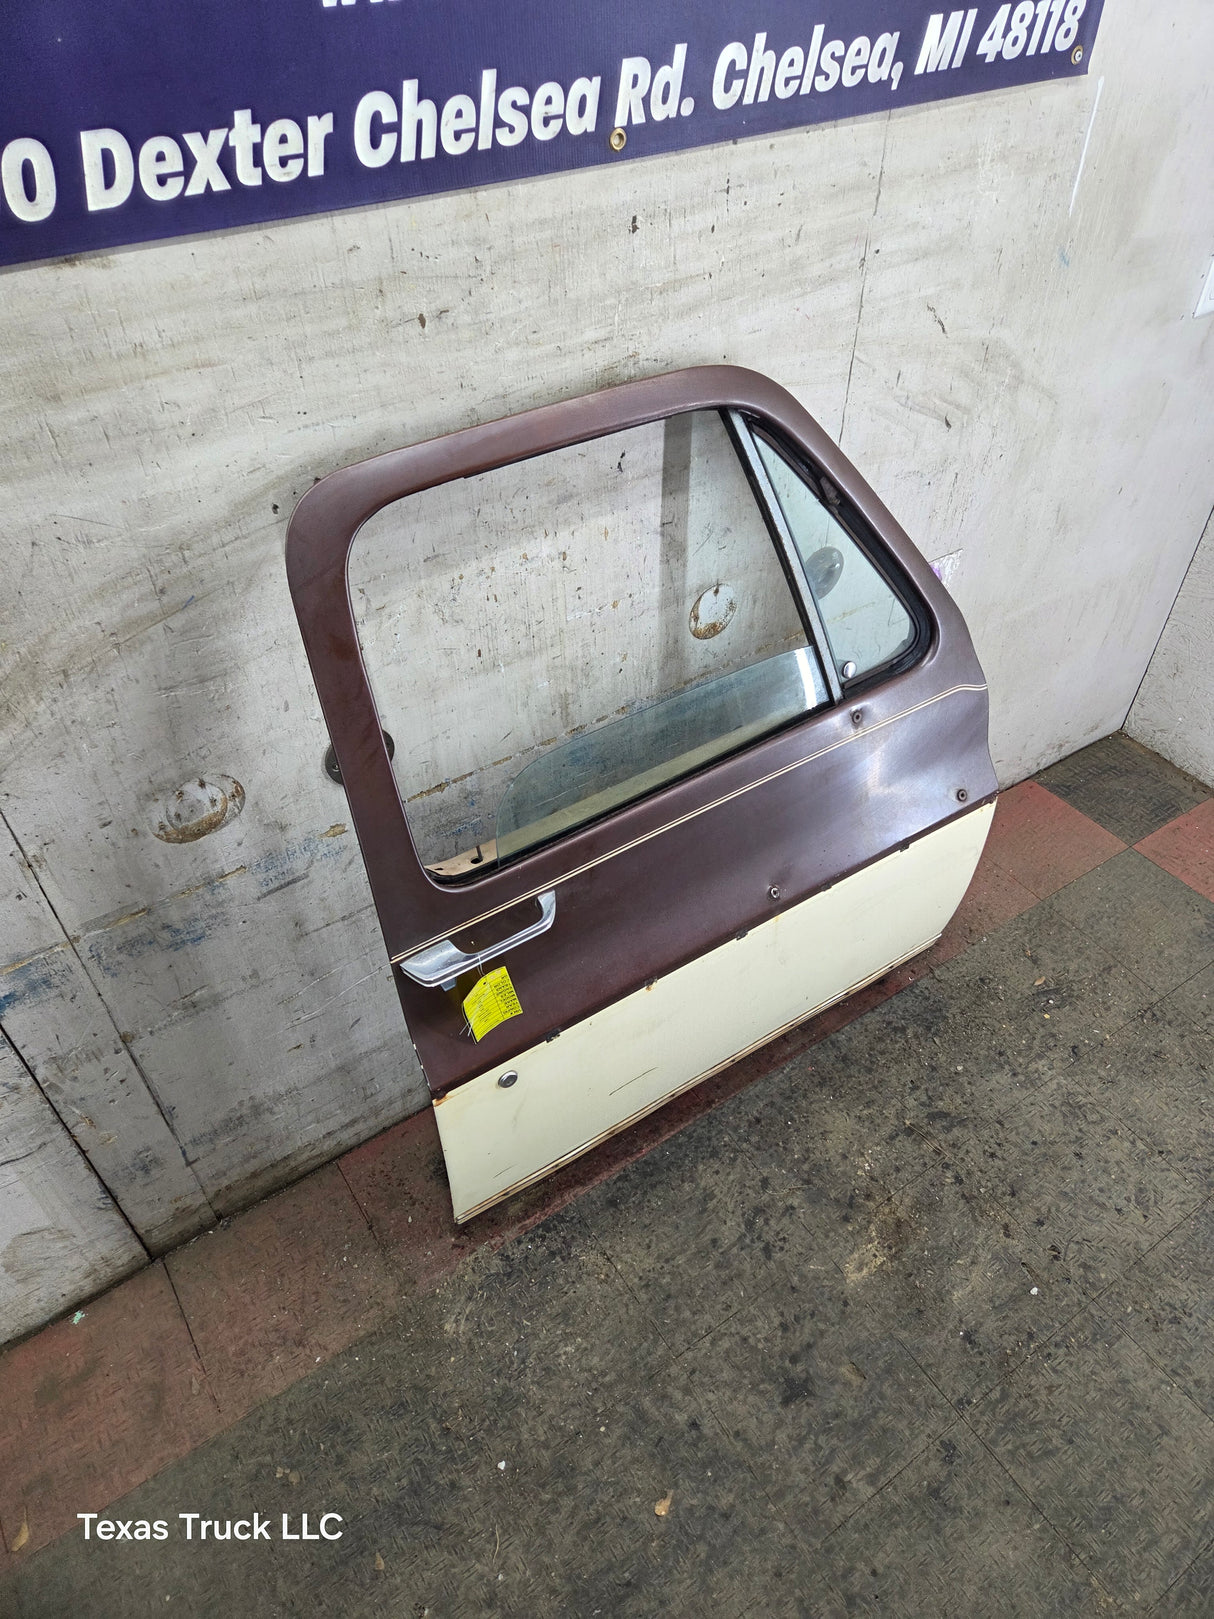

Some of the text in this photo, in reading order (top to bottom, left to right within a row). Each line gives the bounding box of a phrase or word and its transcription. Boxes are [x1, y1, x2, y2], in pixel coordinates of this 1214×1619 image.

[80, 110, 334, 212] Dexter
[353, 68, 602, 168] Chelsea
[614, 42, 695, 128] Rd.
[712, 23, 901, 110] Chelsea,
[914, 8, 979, 76] MI
[976, 0, 1086, 63] 48118
